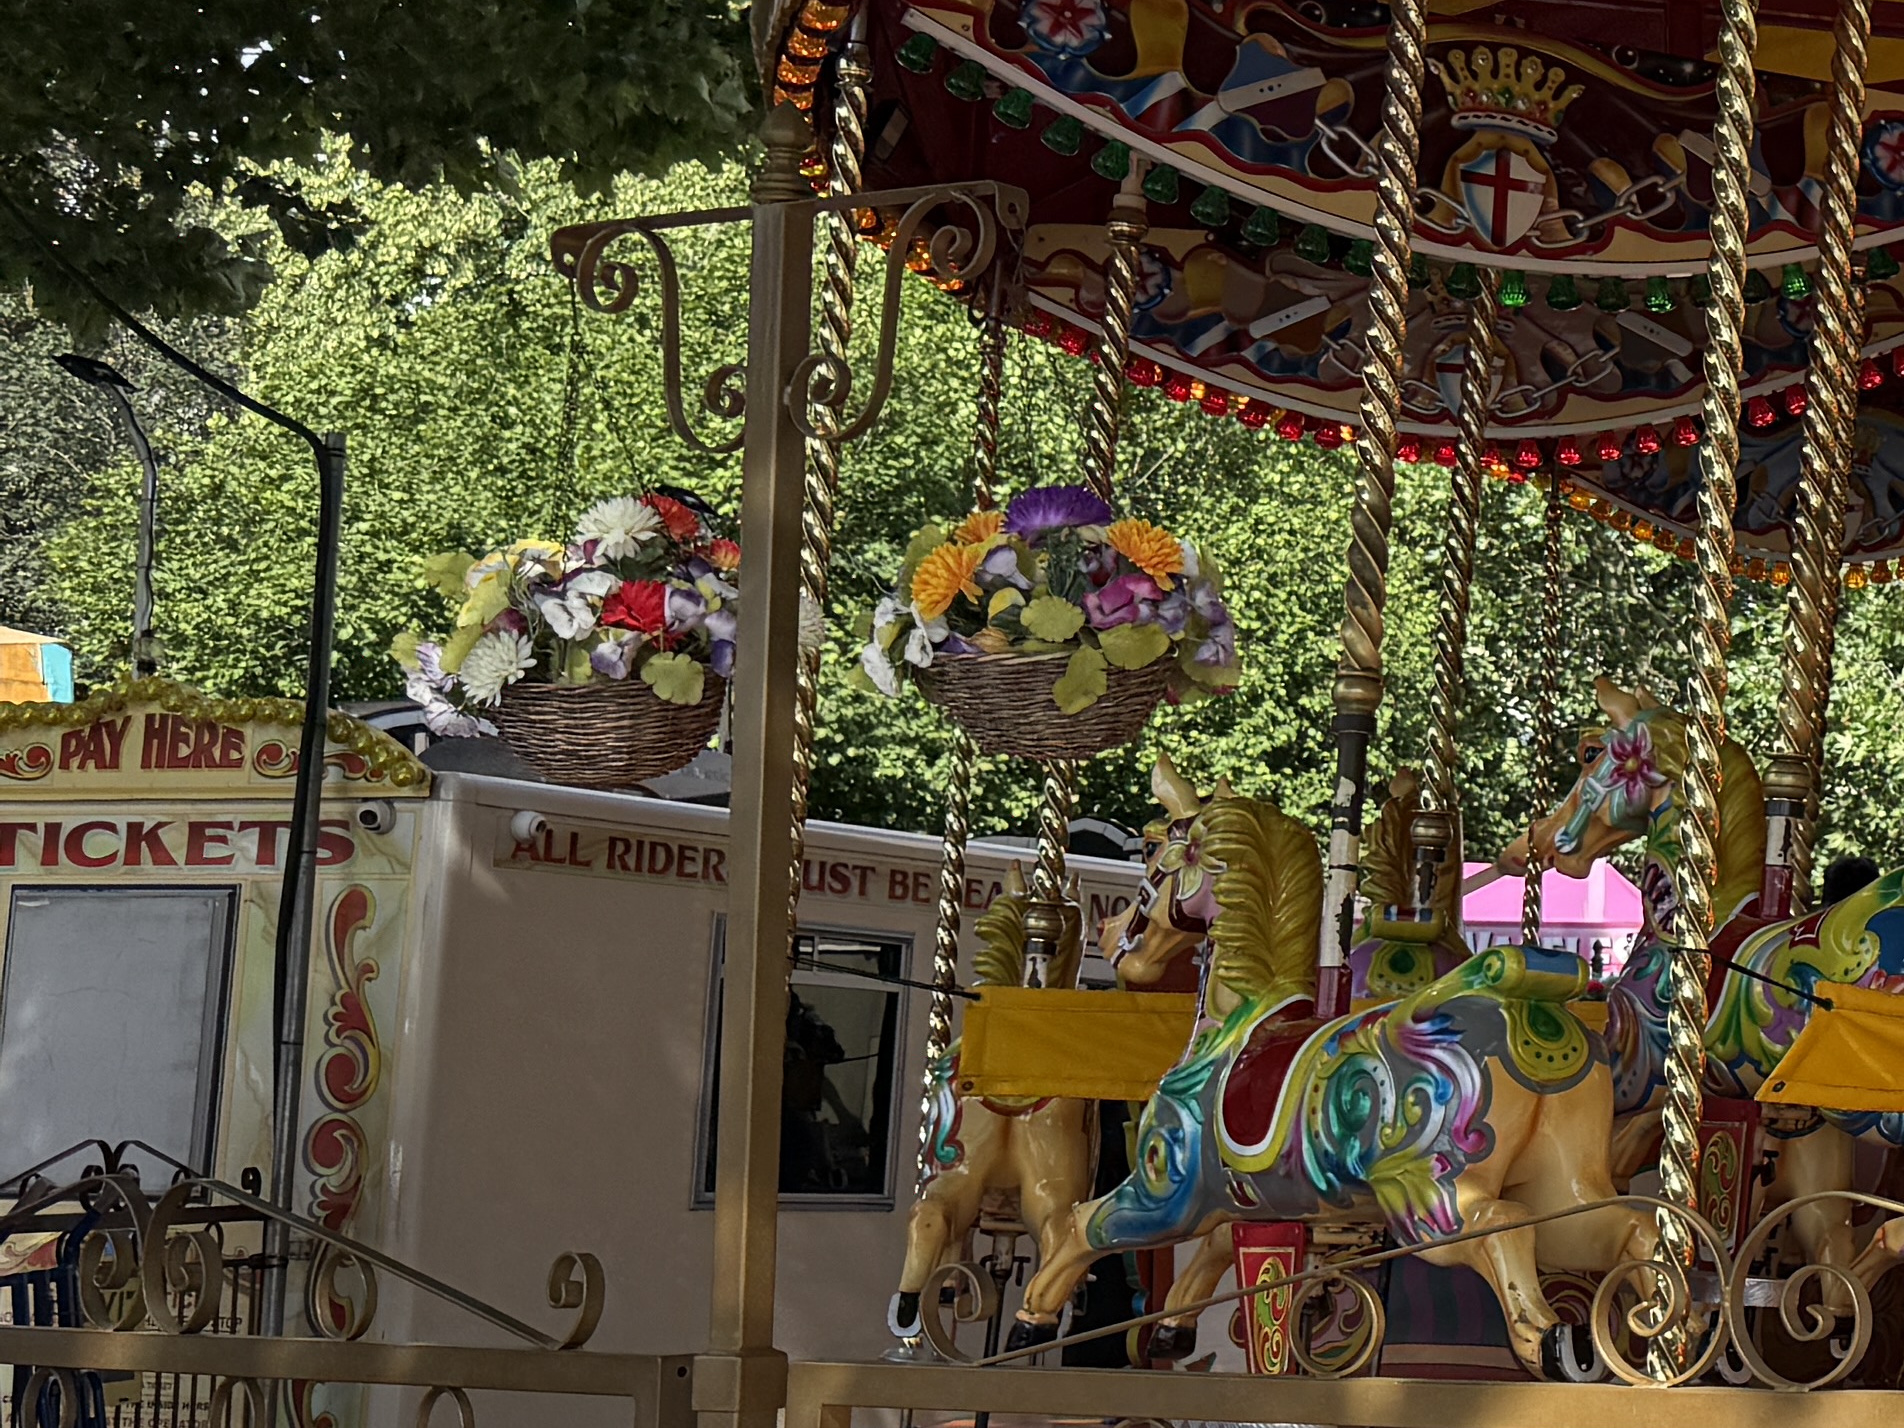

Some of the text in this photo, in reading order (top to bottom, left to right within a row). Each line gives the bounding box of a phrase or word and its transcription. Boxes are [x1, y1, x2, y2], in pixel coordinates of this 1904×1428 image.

[58, 712, 246, 770] PAY HERE
[887, 867, 934, 905] BE
